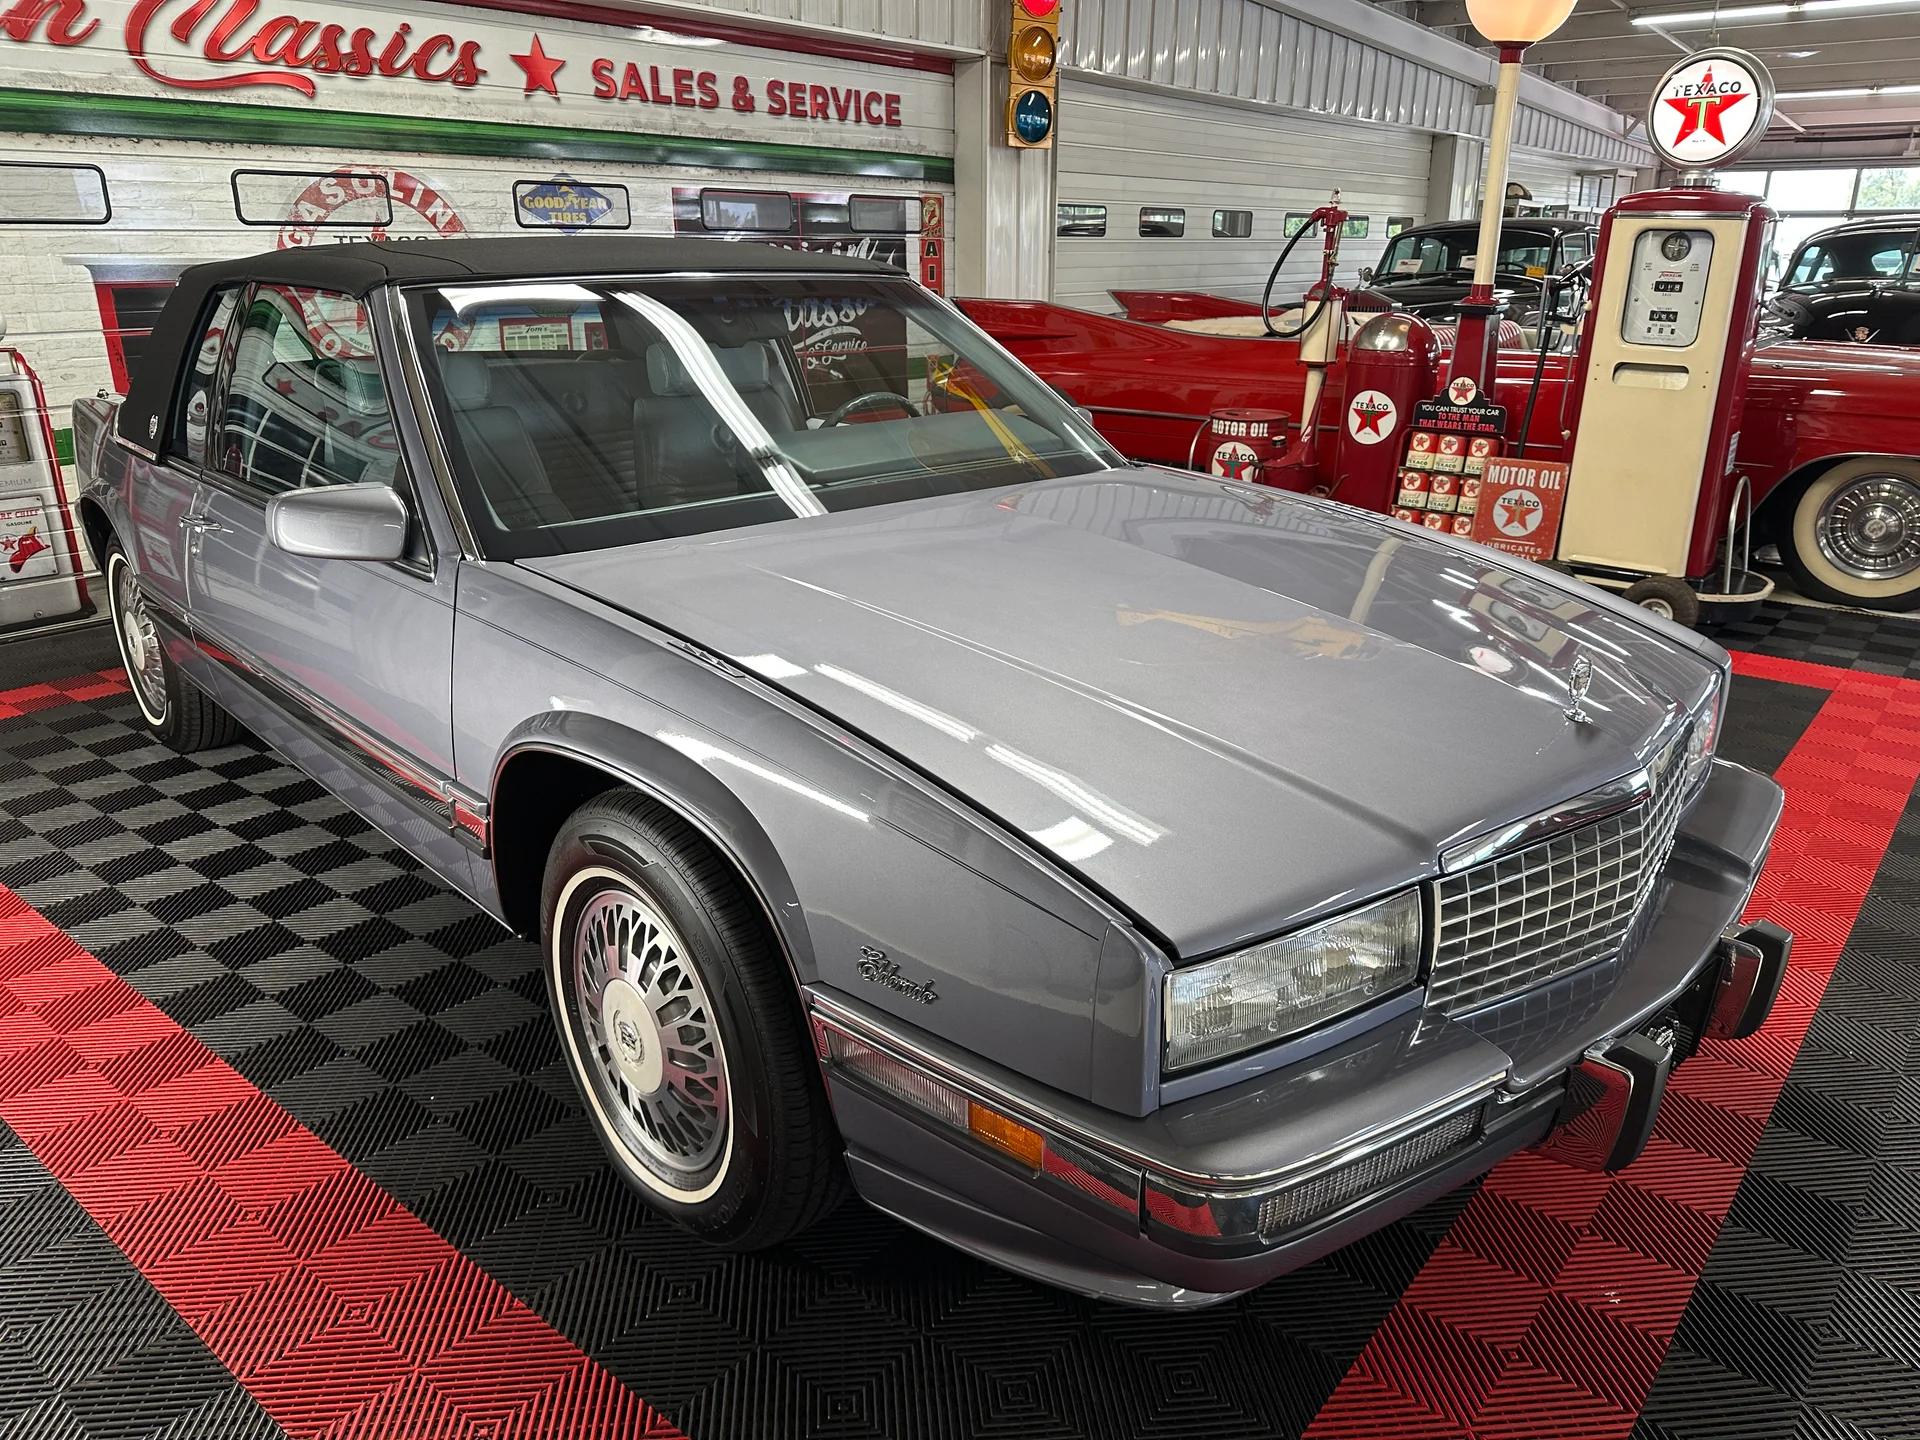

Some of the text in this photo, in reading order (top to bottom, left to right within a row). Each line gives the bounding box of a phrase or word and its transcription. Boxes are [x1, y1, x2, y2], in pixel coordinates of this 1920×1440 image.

[125, 0, 487, 98] Classics
[591, 57, 903, 126] SALES & SERVICE
[1673, 81, 1742, 97] TEXACO
[280, 168, 456, 248] GASOLIN
[548, 212, 587, 224] TIRES
[1356, 401, 1389, 411] TEXACO
[1421, 404, 1500, 416] YOU CAN TRUST YOUR CAR
[1438, 412, 1480, 422] TO THE MAN
[1212, 418, 1269, 437] MOTOR OIL
[1419, 418, 1436, 427] THAT
[1437, 419, 1462, 430] WEARS
[1463, 422, 1476, 431] THE
[1217, 451, 1255, 461] TEXACO
[1487, 465, 1561, 490] MOTOR OIL
[1501, 497, 1540, 508] TEXACO
